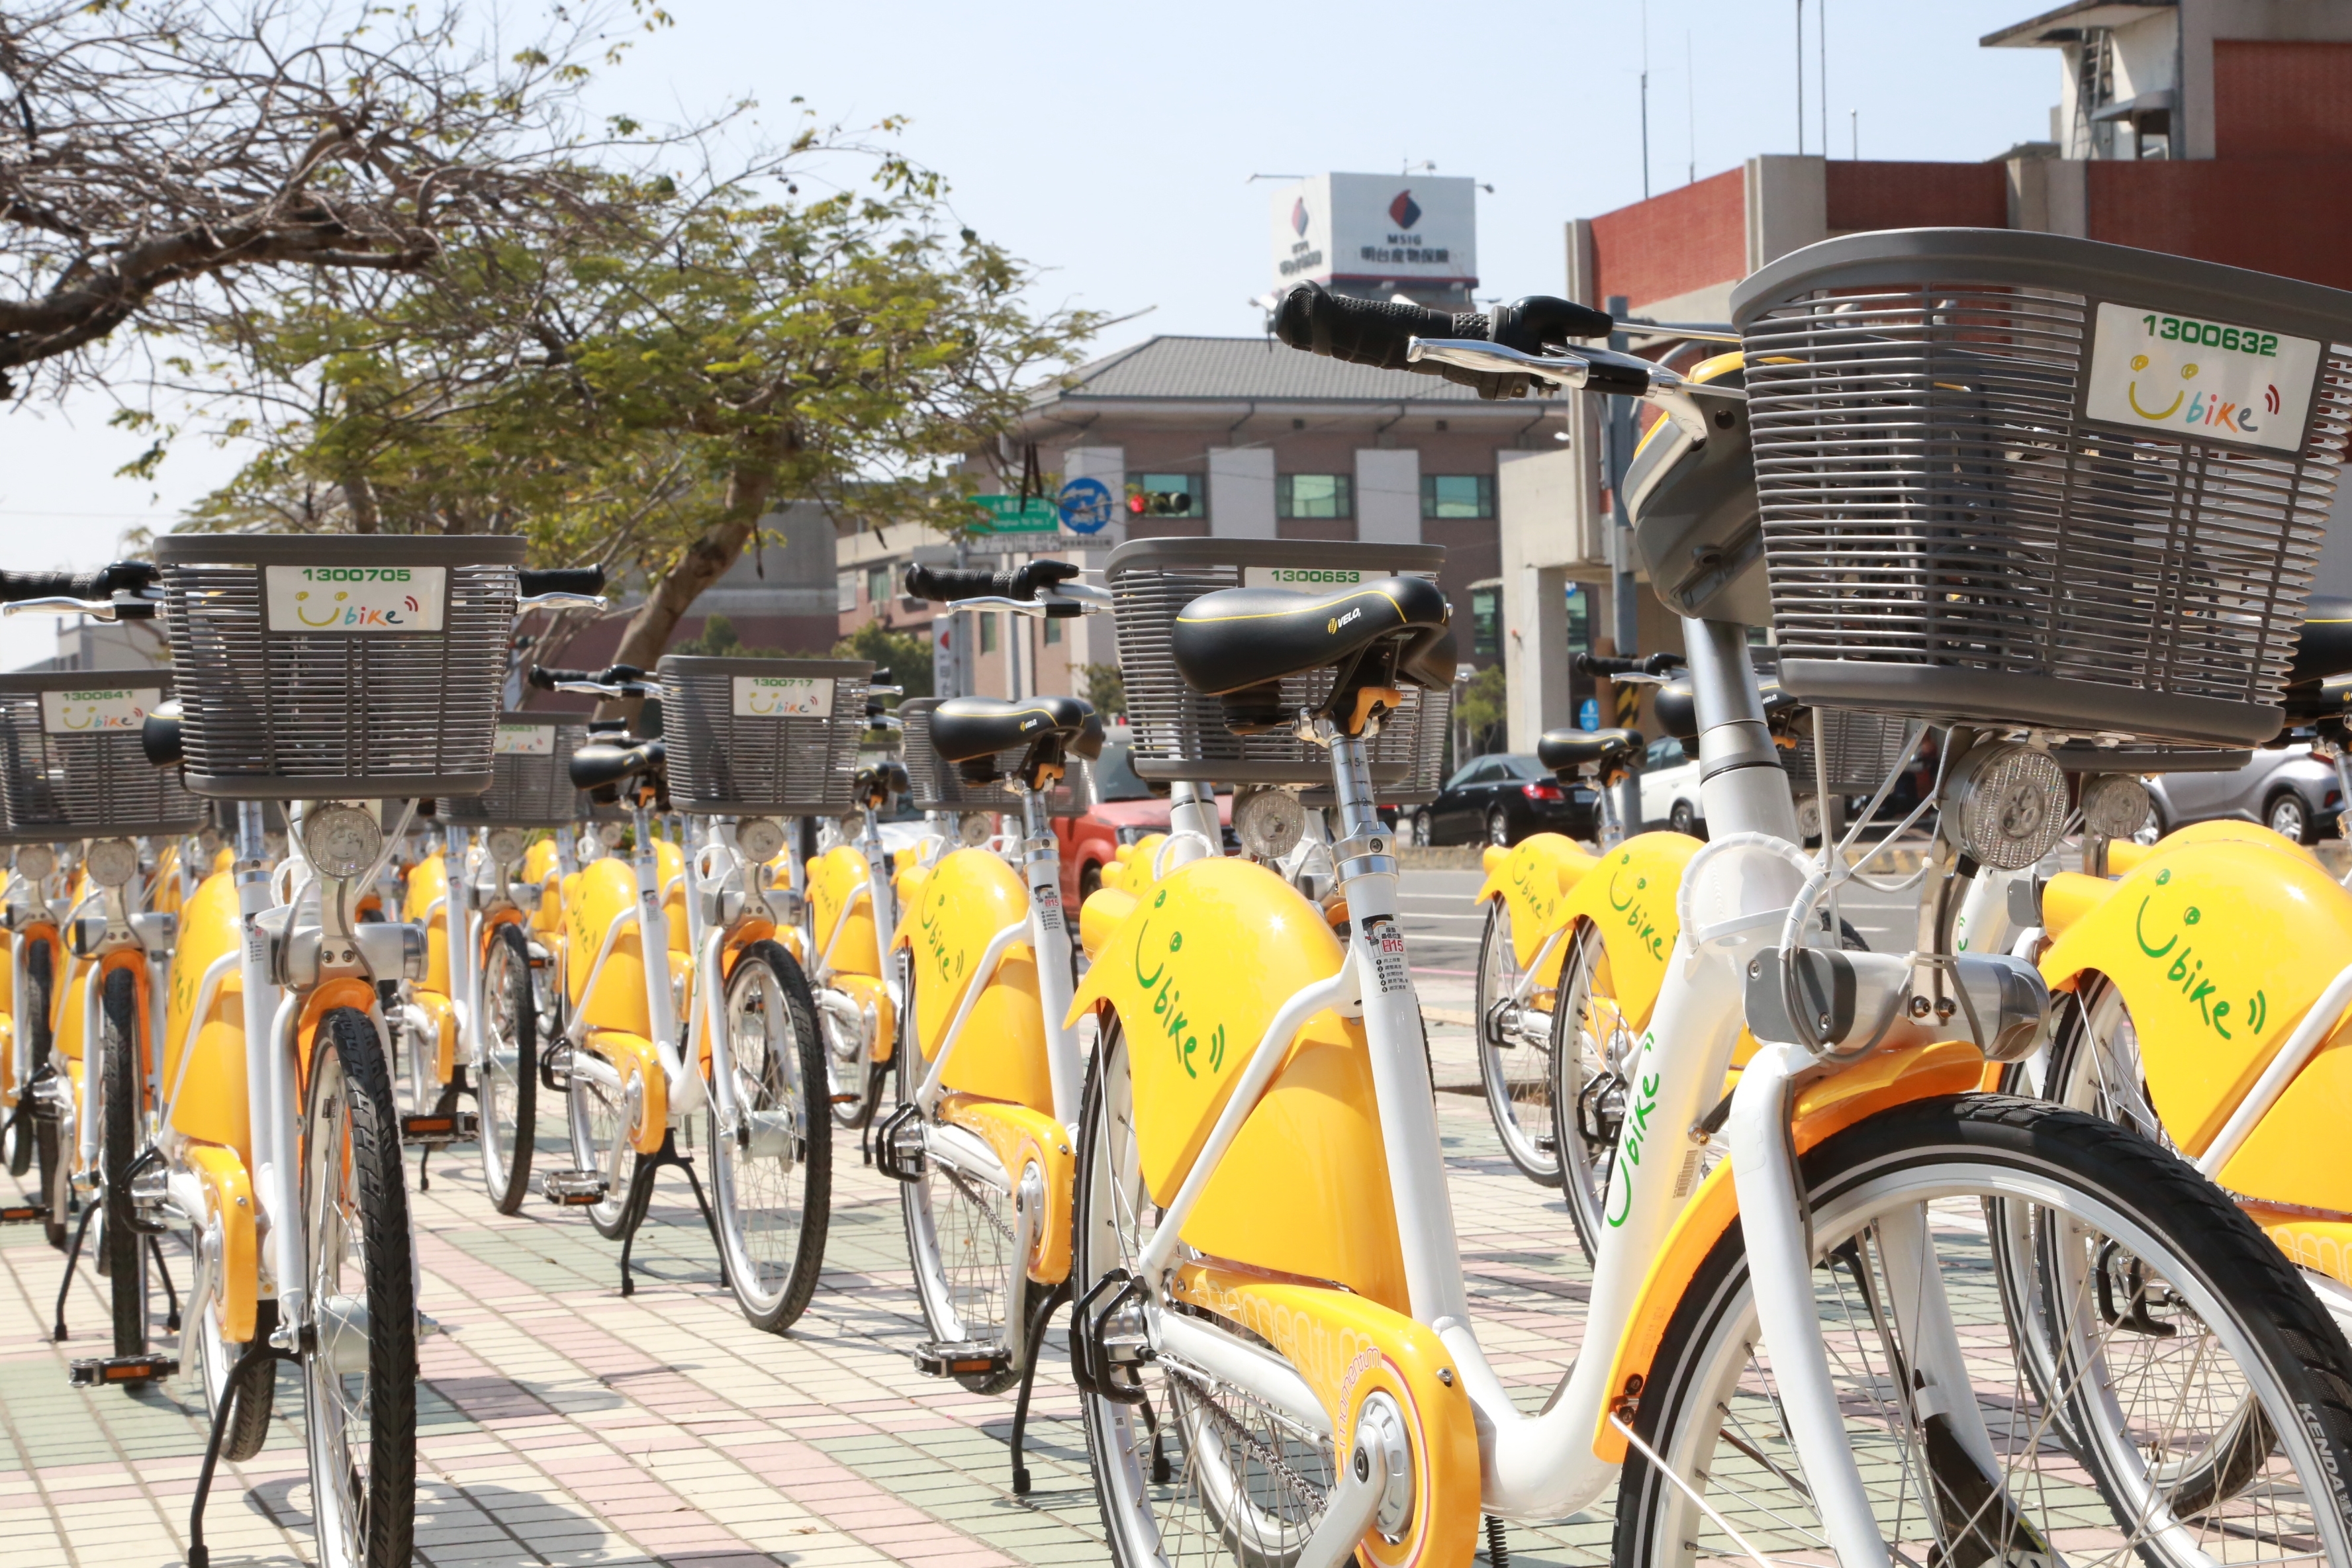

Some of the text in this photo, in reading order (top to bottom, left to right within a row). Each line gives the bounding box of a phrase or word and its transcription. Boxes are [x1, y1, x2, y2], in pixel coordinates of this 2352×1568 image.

[1387, 234, 1422, 246] MSIG
[2143, 315, 2279, 357] 1300632
[302, 569, 411, 582] 1300705
[1271, 570, 1360, 583] 1300653
[1338, 607, 1360, 628] VELO
[753, 678, 814, 687] 1300717
[62, 690, 133, 701] 1300641
[1762, 694, 1777, 705] VELO
[1391, 939, 1403, 952] 15
[1338, 1346, 1382, 1448] momentum
[2297, 1403, 2345, 1492] KENDA
